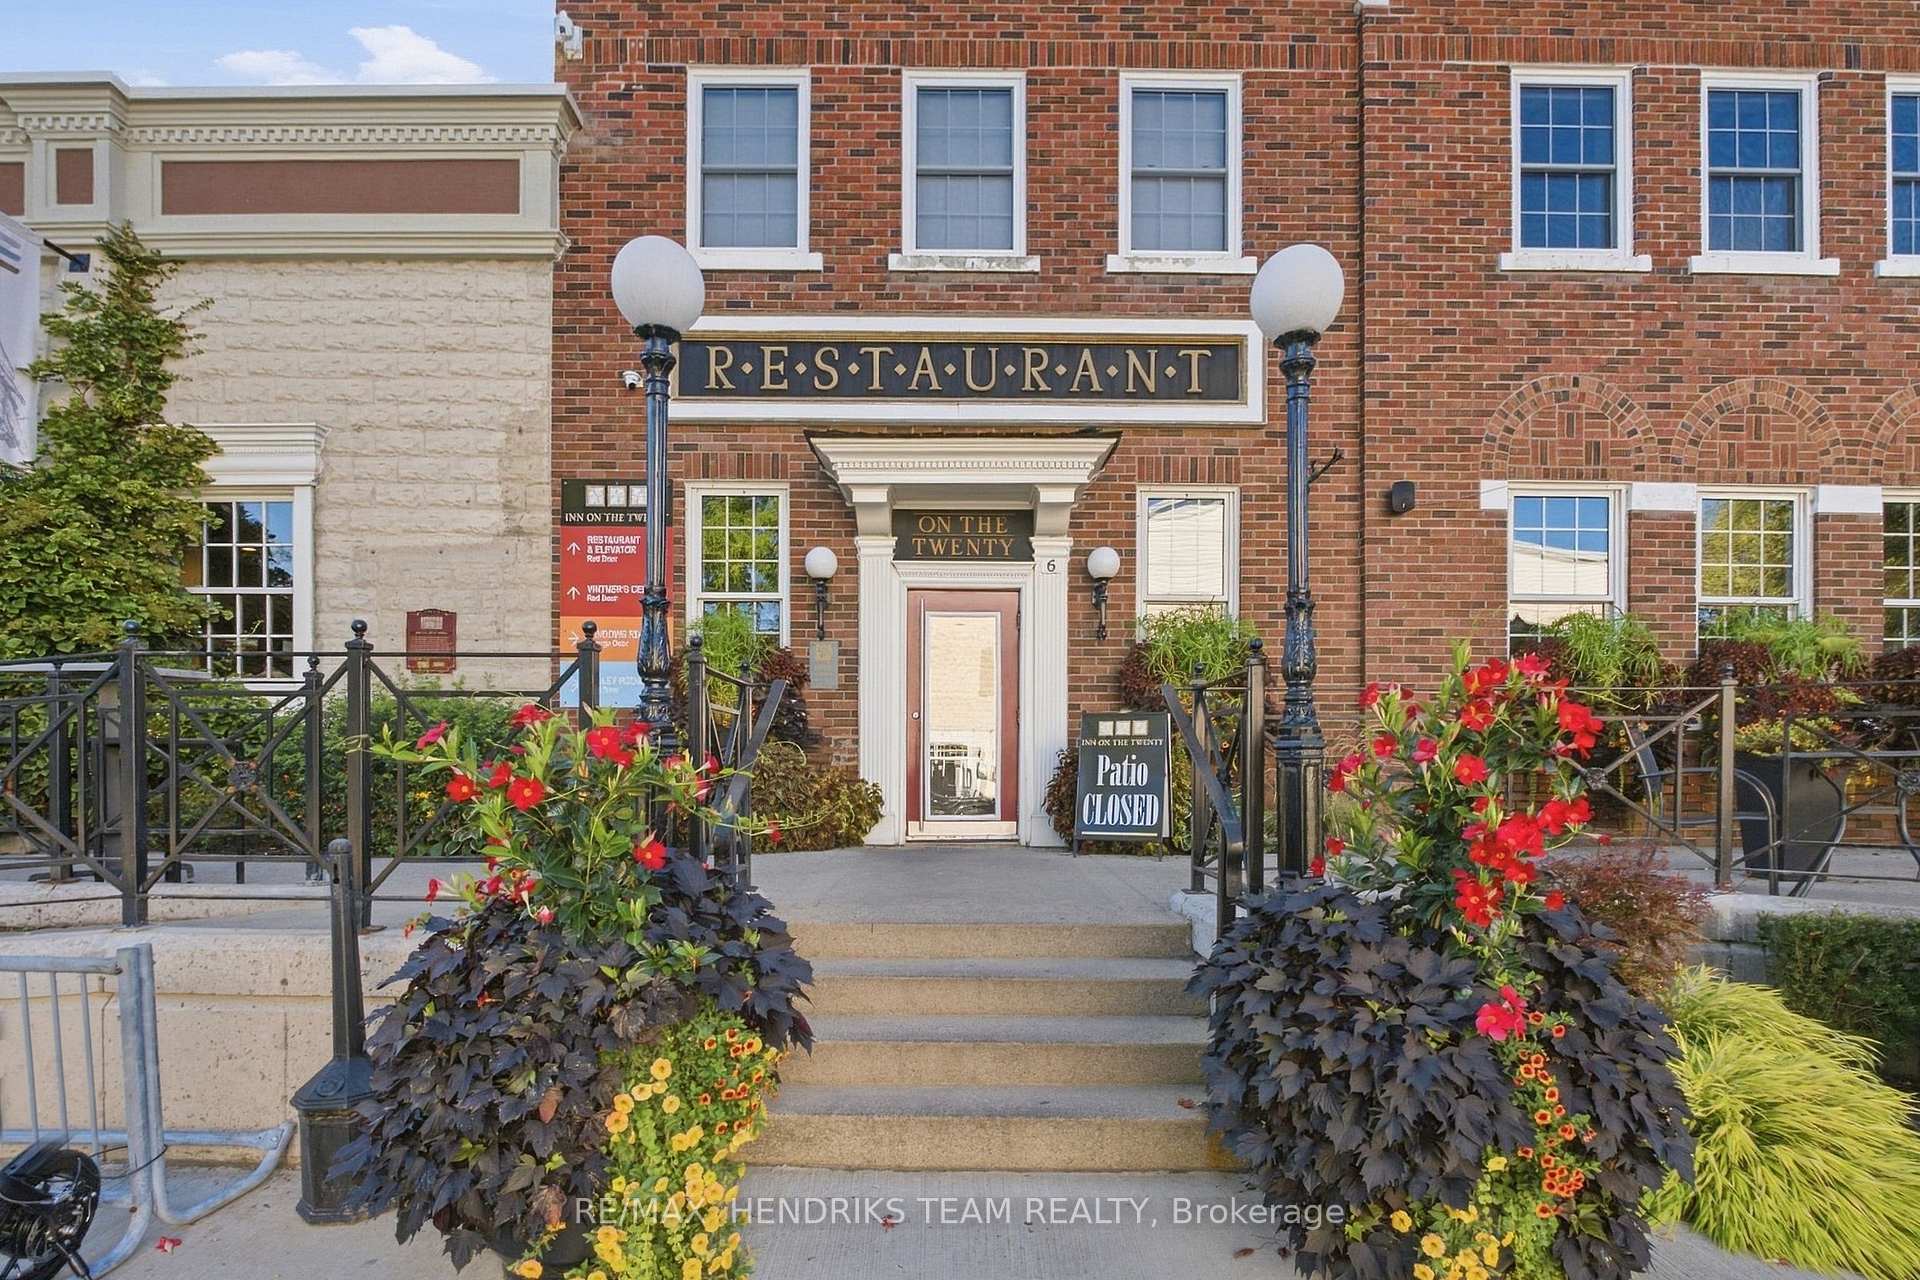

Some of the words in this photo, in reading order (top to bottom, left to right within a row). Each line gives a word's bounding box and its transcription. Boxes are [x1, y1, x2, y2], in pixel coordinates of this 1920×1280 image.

[565, 513, 584, 522] INN
[586, 513, 601, 522] ON
[603, 513, 625, 522] THE
[918, 516, 950, 533] ON
[960, 516, 1009, 534] THE
[587, 535, 641, 544] RESTAURANT
[594, 545, 637, 554] ELEVATOR
[911, 538, 1016, 556] TWENTY
[586, 555, 599, 563] Red
[1046, 559, 1056, 572] 6
[1131, 738, 1164, 746] TWENTY
[1096, 754, 1149, 787] Patio
[1082, 792, 1160, 827] CLOSED
